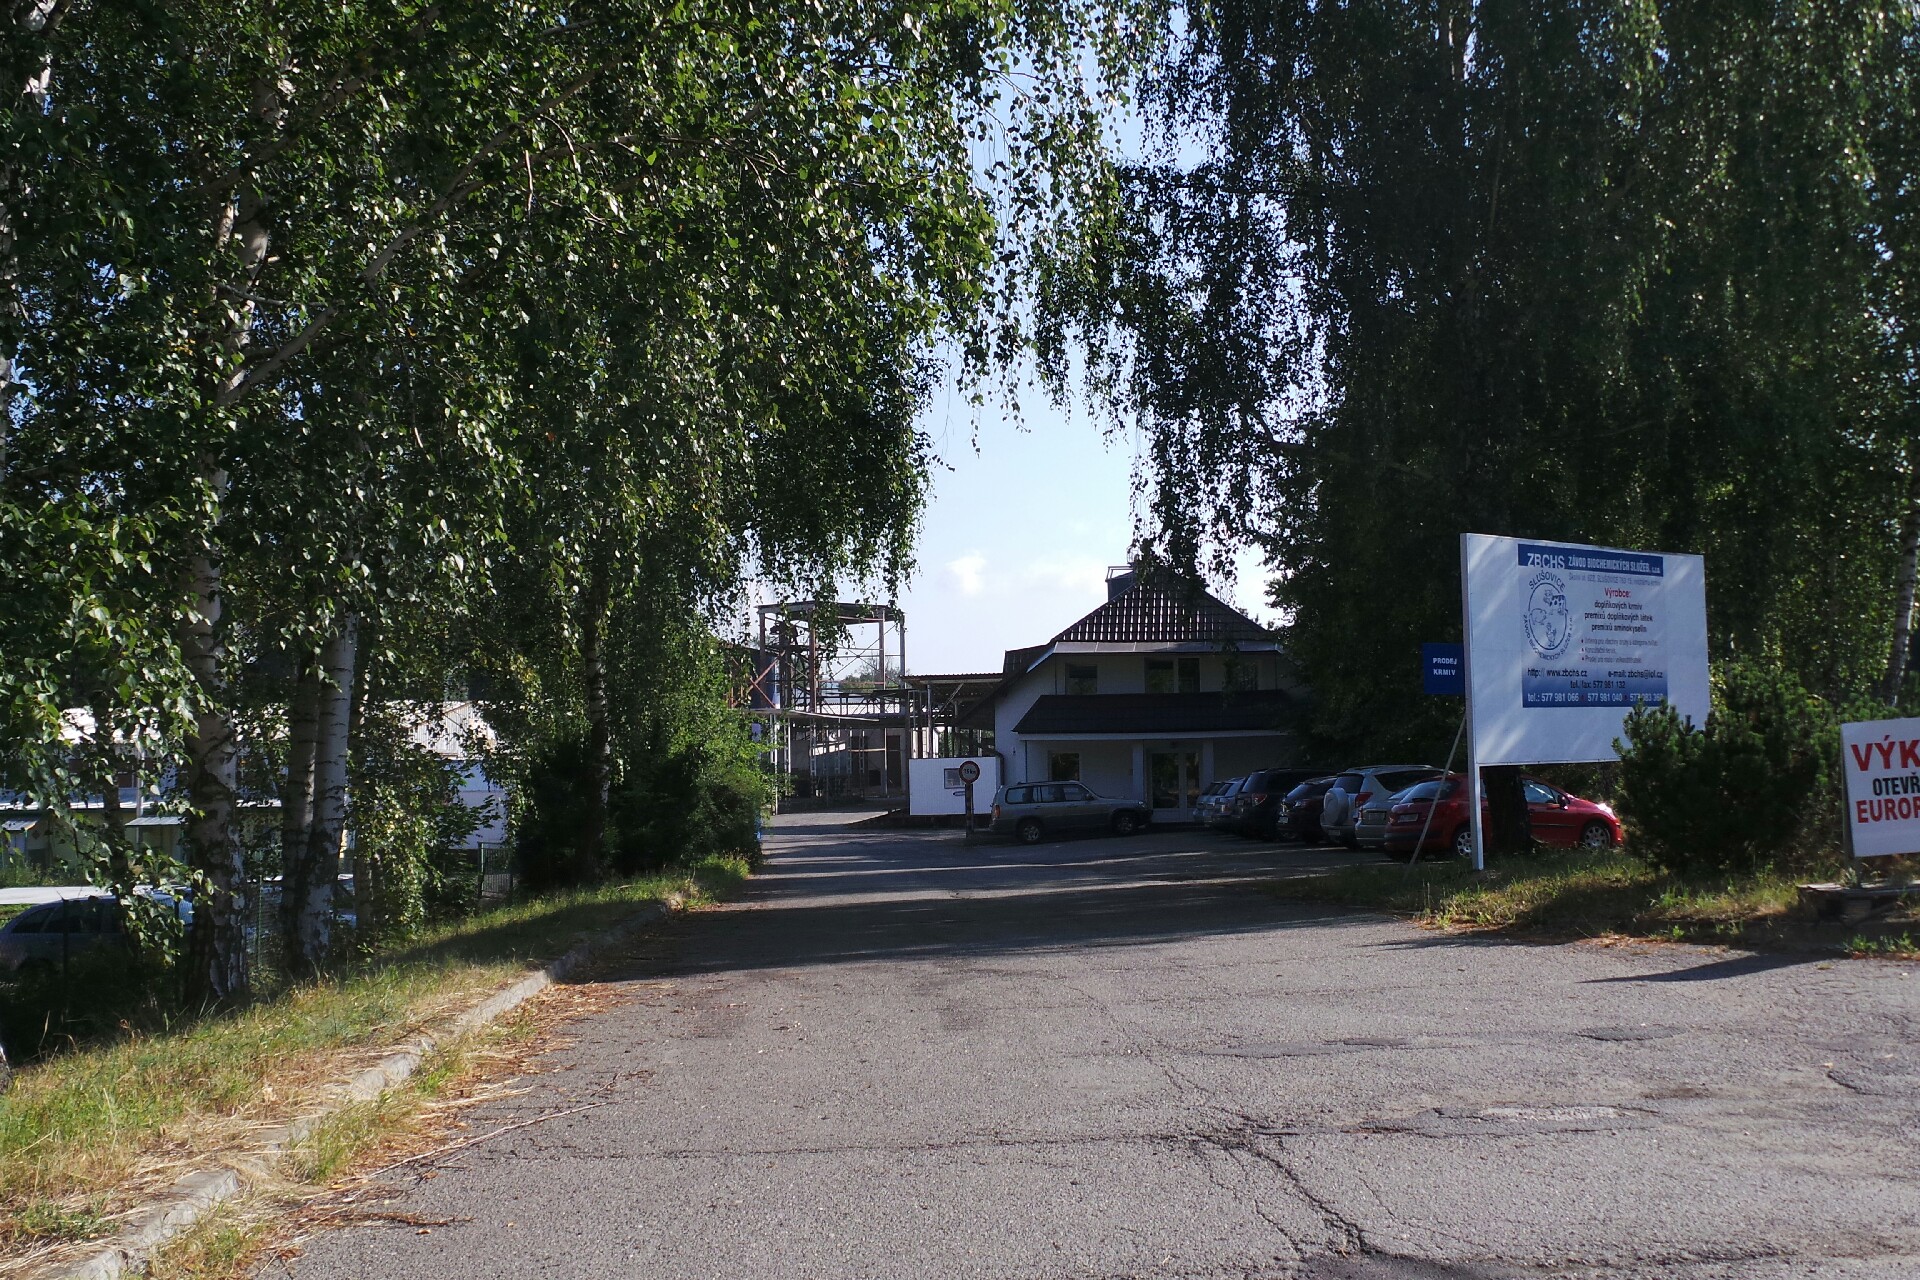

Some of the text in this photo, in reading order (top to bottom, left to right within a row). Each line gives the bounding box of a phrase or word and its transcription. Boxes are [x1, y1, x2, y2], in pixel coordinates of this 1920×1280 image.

[1527, 552, 1565, 569] ZBCHS
[1568, 554, 1586, 568] ZÁVOD
[1587, 558, 1630, 571] BIOCHEMICKÝCH
[1528, 570, 1566, 592] SLUŠOVICE
[1604, 588, 1632, 599] Výrobce:
[1593, 680, 1603, 688] 577
[1616, 681, 1625, 689] 132
[1542, 693, 1553, 702] 577
[1555, 693, 1565, 702] 981
[1588, 693, 1598, 702] 577
[1851, 734, 1920, 772] VÝK
[1872, 772, 1920, 796] OTEVŘ
